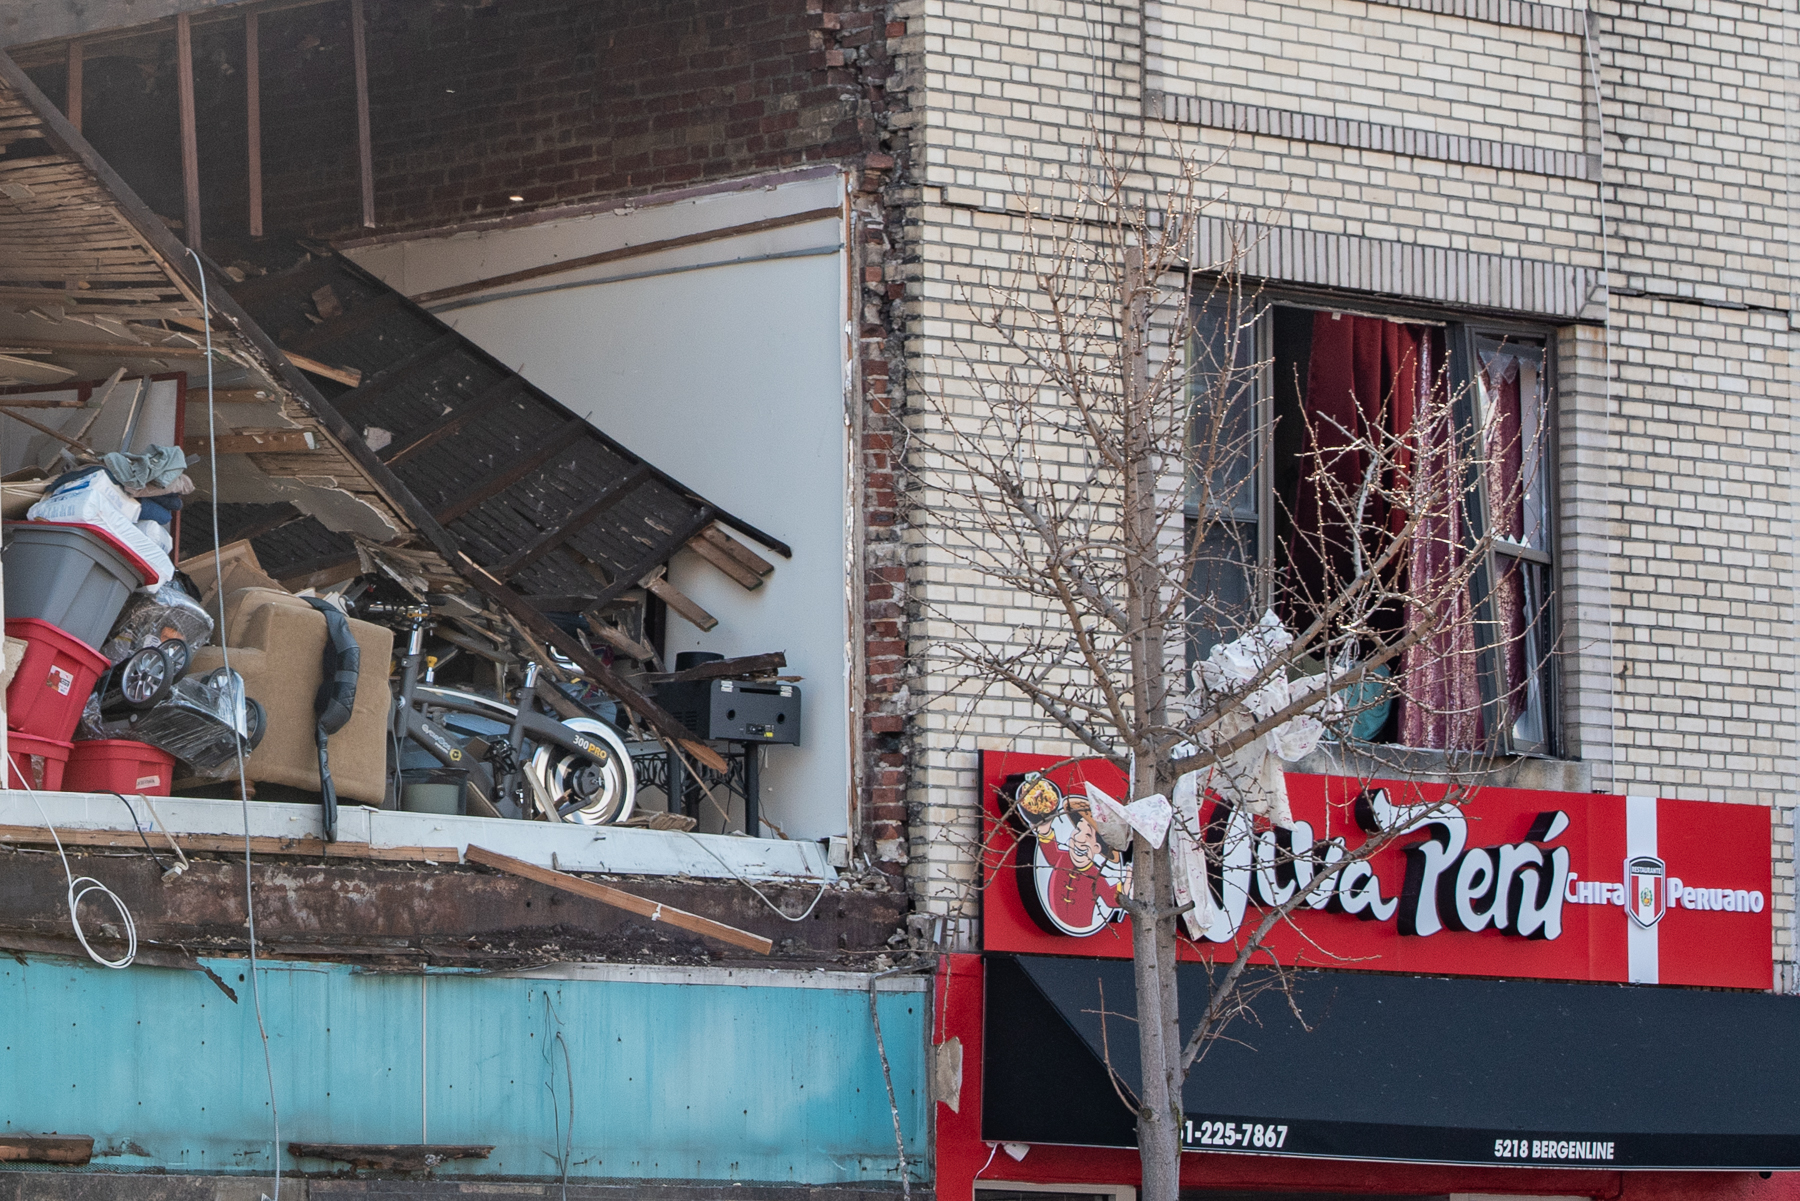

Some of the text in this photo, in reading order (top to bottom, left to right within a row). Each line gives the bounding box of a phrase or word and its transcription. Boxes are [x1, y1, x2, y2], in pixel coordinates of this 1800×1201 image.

[1370, 787, 1571, 941] Perú
[1180, 1120, 1289, 1149] 1-225-7867
[1494, 1139, 1615, 1160] 5218 BERGENLINE
